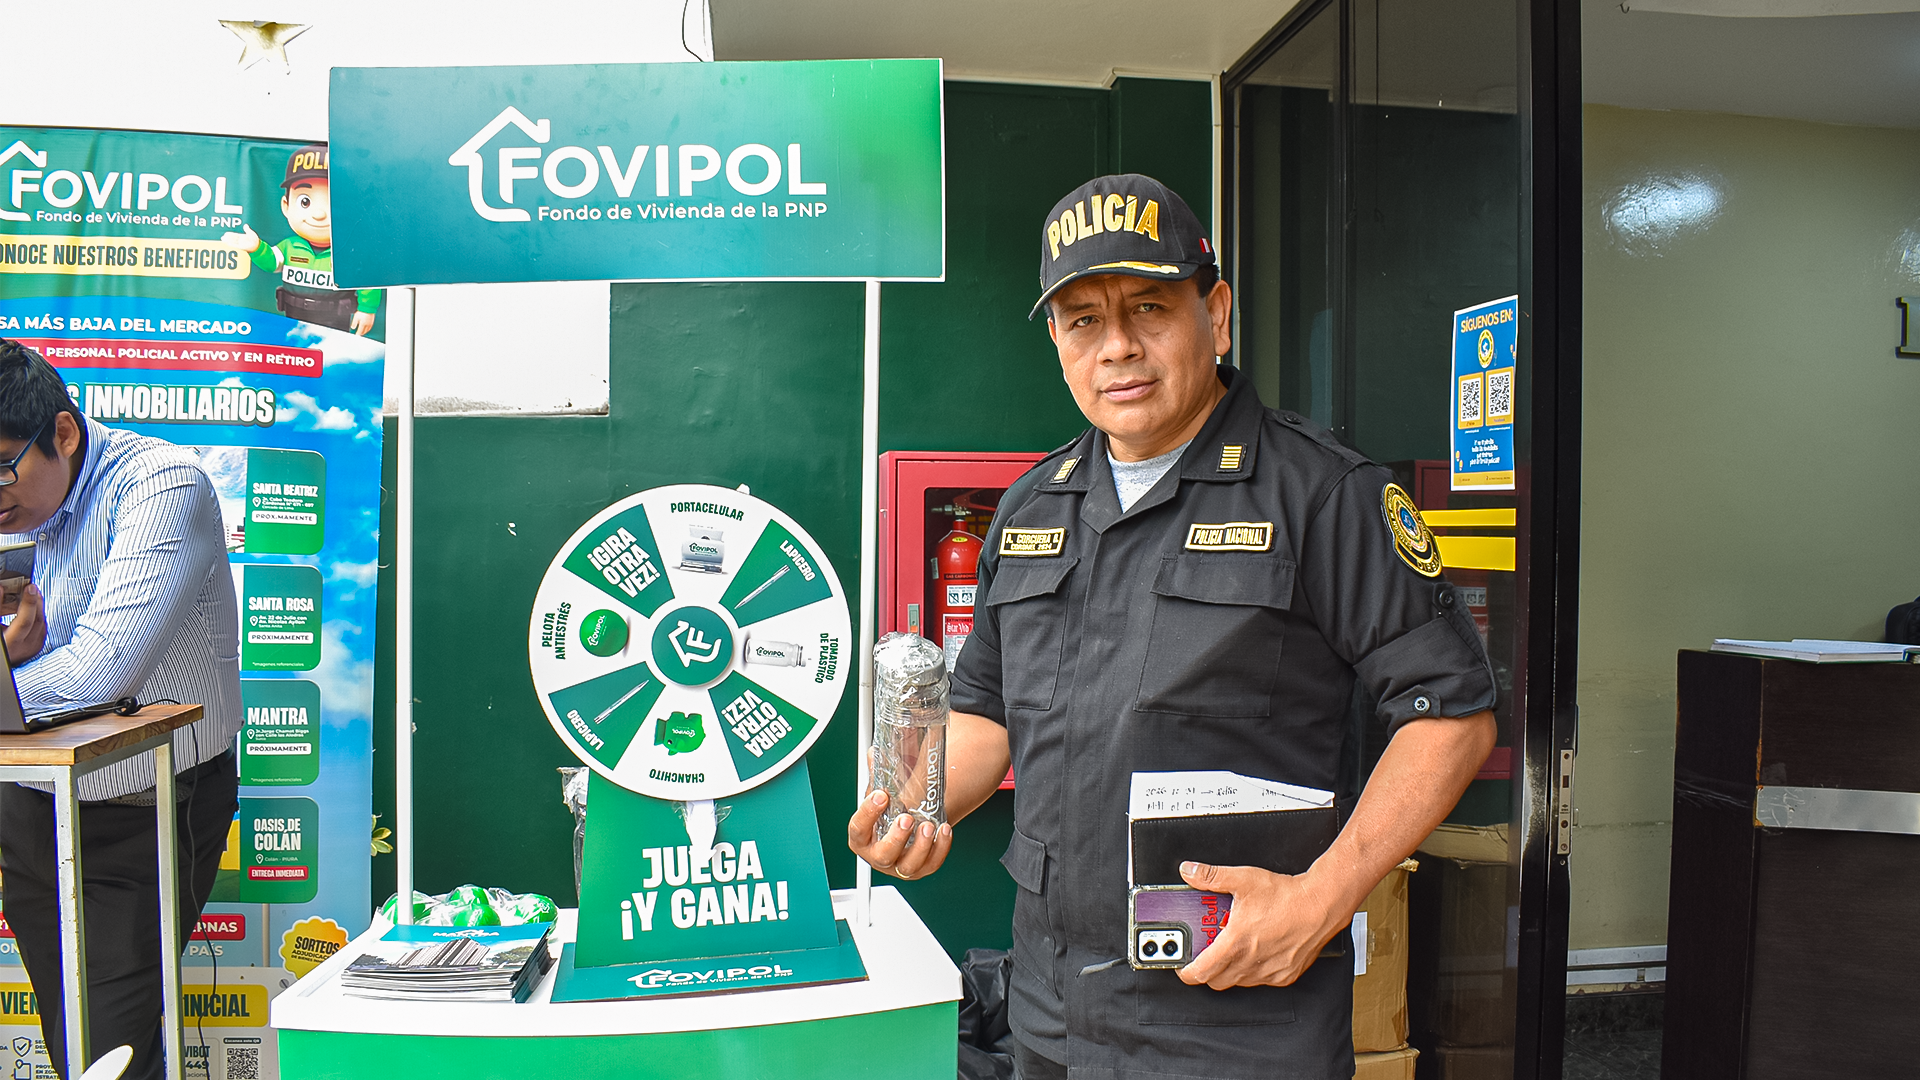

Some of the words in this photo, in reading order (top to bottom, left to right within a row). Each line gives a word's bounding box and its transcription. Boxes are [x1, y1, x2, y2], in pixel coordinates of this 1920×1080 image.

[499, 143, 827, 204] FOVIPOL
[11, 168, 243, 215] FOVIPOL
[36, 210, 82, 223] Fondo
[85, 211, 103, 224] de
[105, 211, 169, 226] Vivienda
[172, 215, 191, 227] de
[194, 216, 207, 228] la
[210, 216, 242, 229] PNP
[538, 205, 602, 221] Fondo
[606, 204, 632, 220] de
[637, 202, 725, 220] Vivienda
[731, 202, 757, 219] de
[762, 201, 779, 218] la
[785, 202, 828, 218] PNP
[53, 244, 138, 267] NUESTROS
[143, 247, 238, 271] BENEFICIOS
[25, 313, 65, 331] MÁS
[70, 317, 117, 331] BAJA
[120, 317, 156, 333] DEL
[160, 319, 252, 336] MERCADO
[1461, 315, 1499, 333] SÍGUENOS
[1500, 308, 1513, 323] EN:
[46, 346, 115, 358] PERSONAL
[118, 348, 178, 360] POLICIAL
[180, 350, 229, 361] ACTIVO
[231, 351, 242, 361] Y
[244, 352, 263, 363] EN
[266, 353, 315, 367] RETIRO
[85, 383, 276, 424] INMOBILIARIOS
[253, 482, 282, 495] SANTA
[283, 484, 319, 498] BEATRIZ
[670, 501, 744, 522] PORTACELULAR
[586, 526, 637, 572] ¡GIRA
[1225, 527, 1264, 545] NACIONAL
[602, 545, 650, 586] OTRA
[779, 539, 816, 582] LAPICERO
[617, 563, 661, 599] VEZ!
[248, 597, 284, 611] SANTA
[285, 597, 315, 612] ROSA
[541, 612, 556, 648] PELOTA
[554, 601, 572, 660] ANTIESTRÉS
[819, 633, 829, 644] DE
[814, 645, 829, 684] PLASTICO
[825, 637, 839, 681] TOMATODO
[247, 707, 309, 726] MANTRA
[720, 689, 762, 725] VEZ!
[731, 701, 778, 740] OTRA
[566, 708, 605, 751] LAPICERO
[743, 717, 793, 759] ¡GIRA
[649, 768, 705, 783] CHANCHITO
[927, 741, 940, 811] FOVIPOL
[254, 818, 285, 831] OASIS
[287, 818, 301, 831] DE
[254, 829, 301, 851] COLÁN
[251, 869, 275, 877] ENTREGA
[275, 869, 305, 878] INMEDIATA
[642, 840, 764, 889] JUEGA
[620, 891, 658, 941] ¡Y
[671, 881, 789, 930] GANA!
[1202, 895, 1218, 926] Bull
[189, 943, 224, 956] PAÍS
[295, 936, 340, 955] SORTEOS
[650, 965, 793, 985] FOVIPOL
[184, 993, 250, 1018] INICIAL
